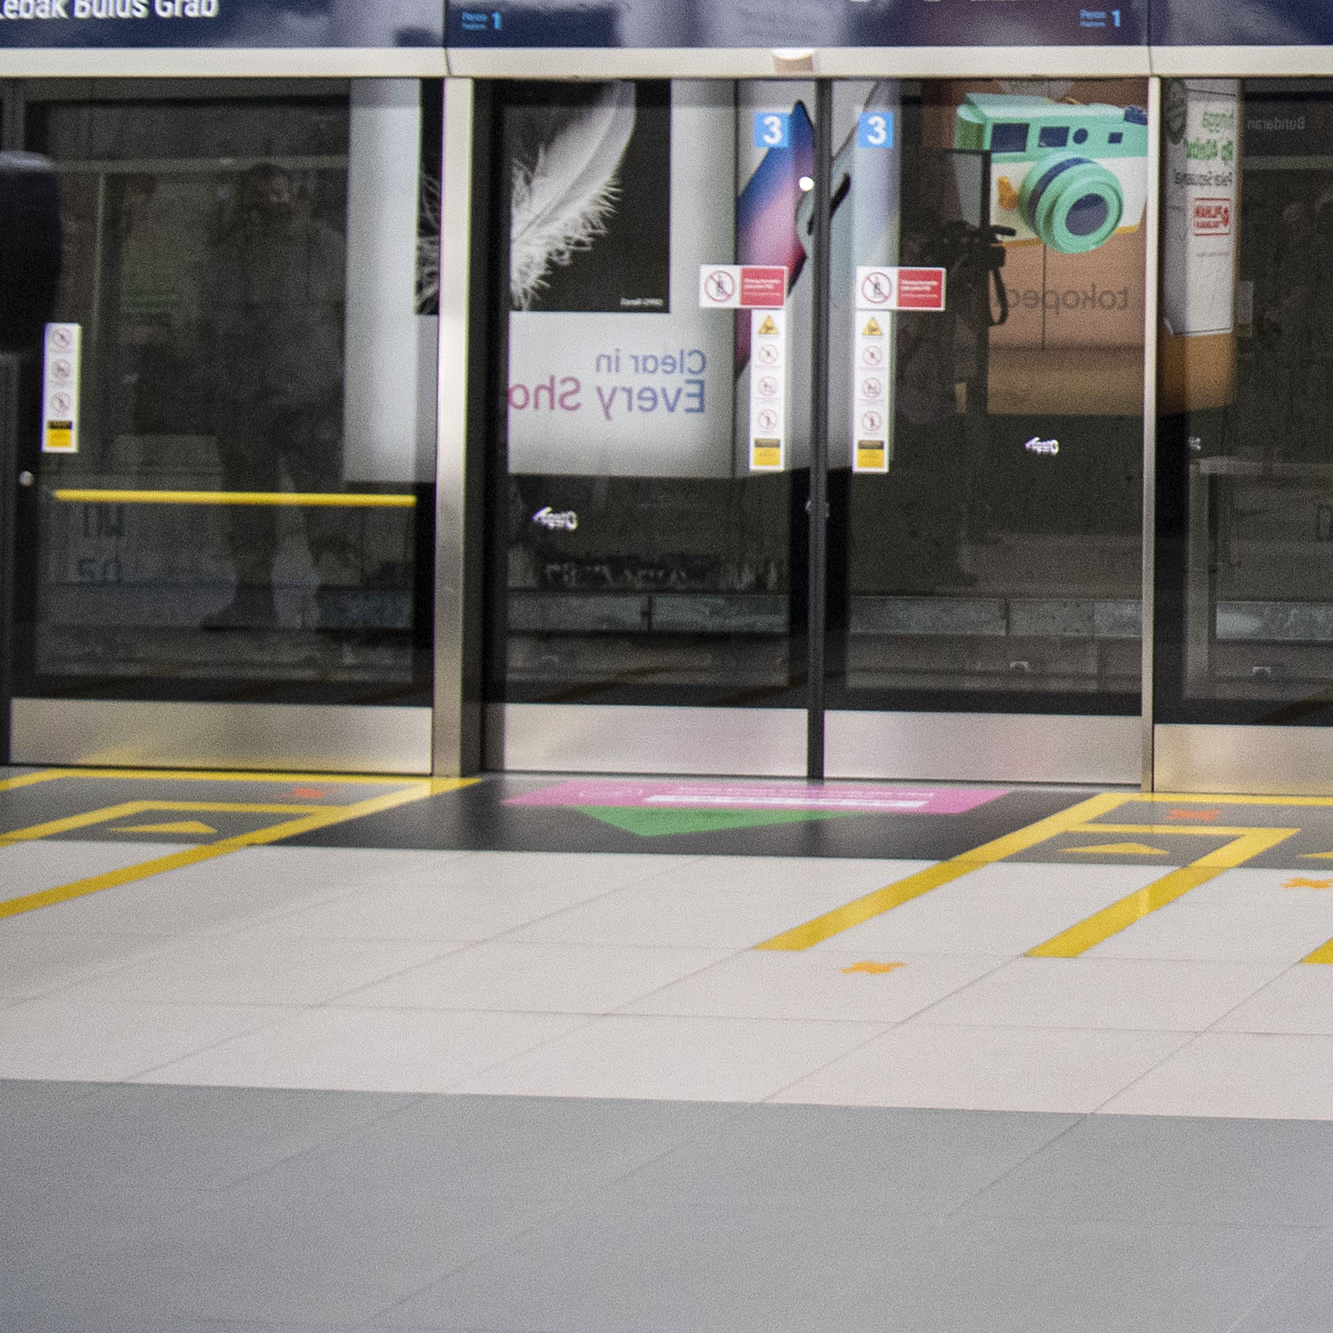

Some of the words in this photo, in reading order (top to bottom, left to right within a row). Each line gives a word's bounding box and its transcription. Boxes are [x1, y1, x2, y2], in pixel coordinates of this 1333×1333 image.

[491, 12, 501, 30] 1
[1111, 9, 1121, 27] 1
[763, 115, 783, 144] 3
[866, 116, 888, 145] 3
